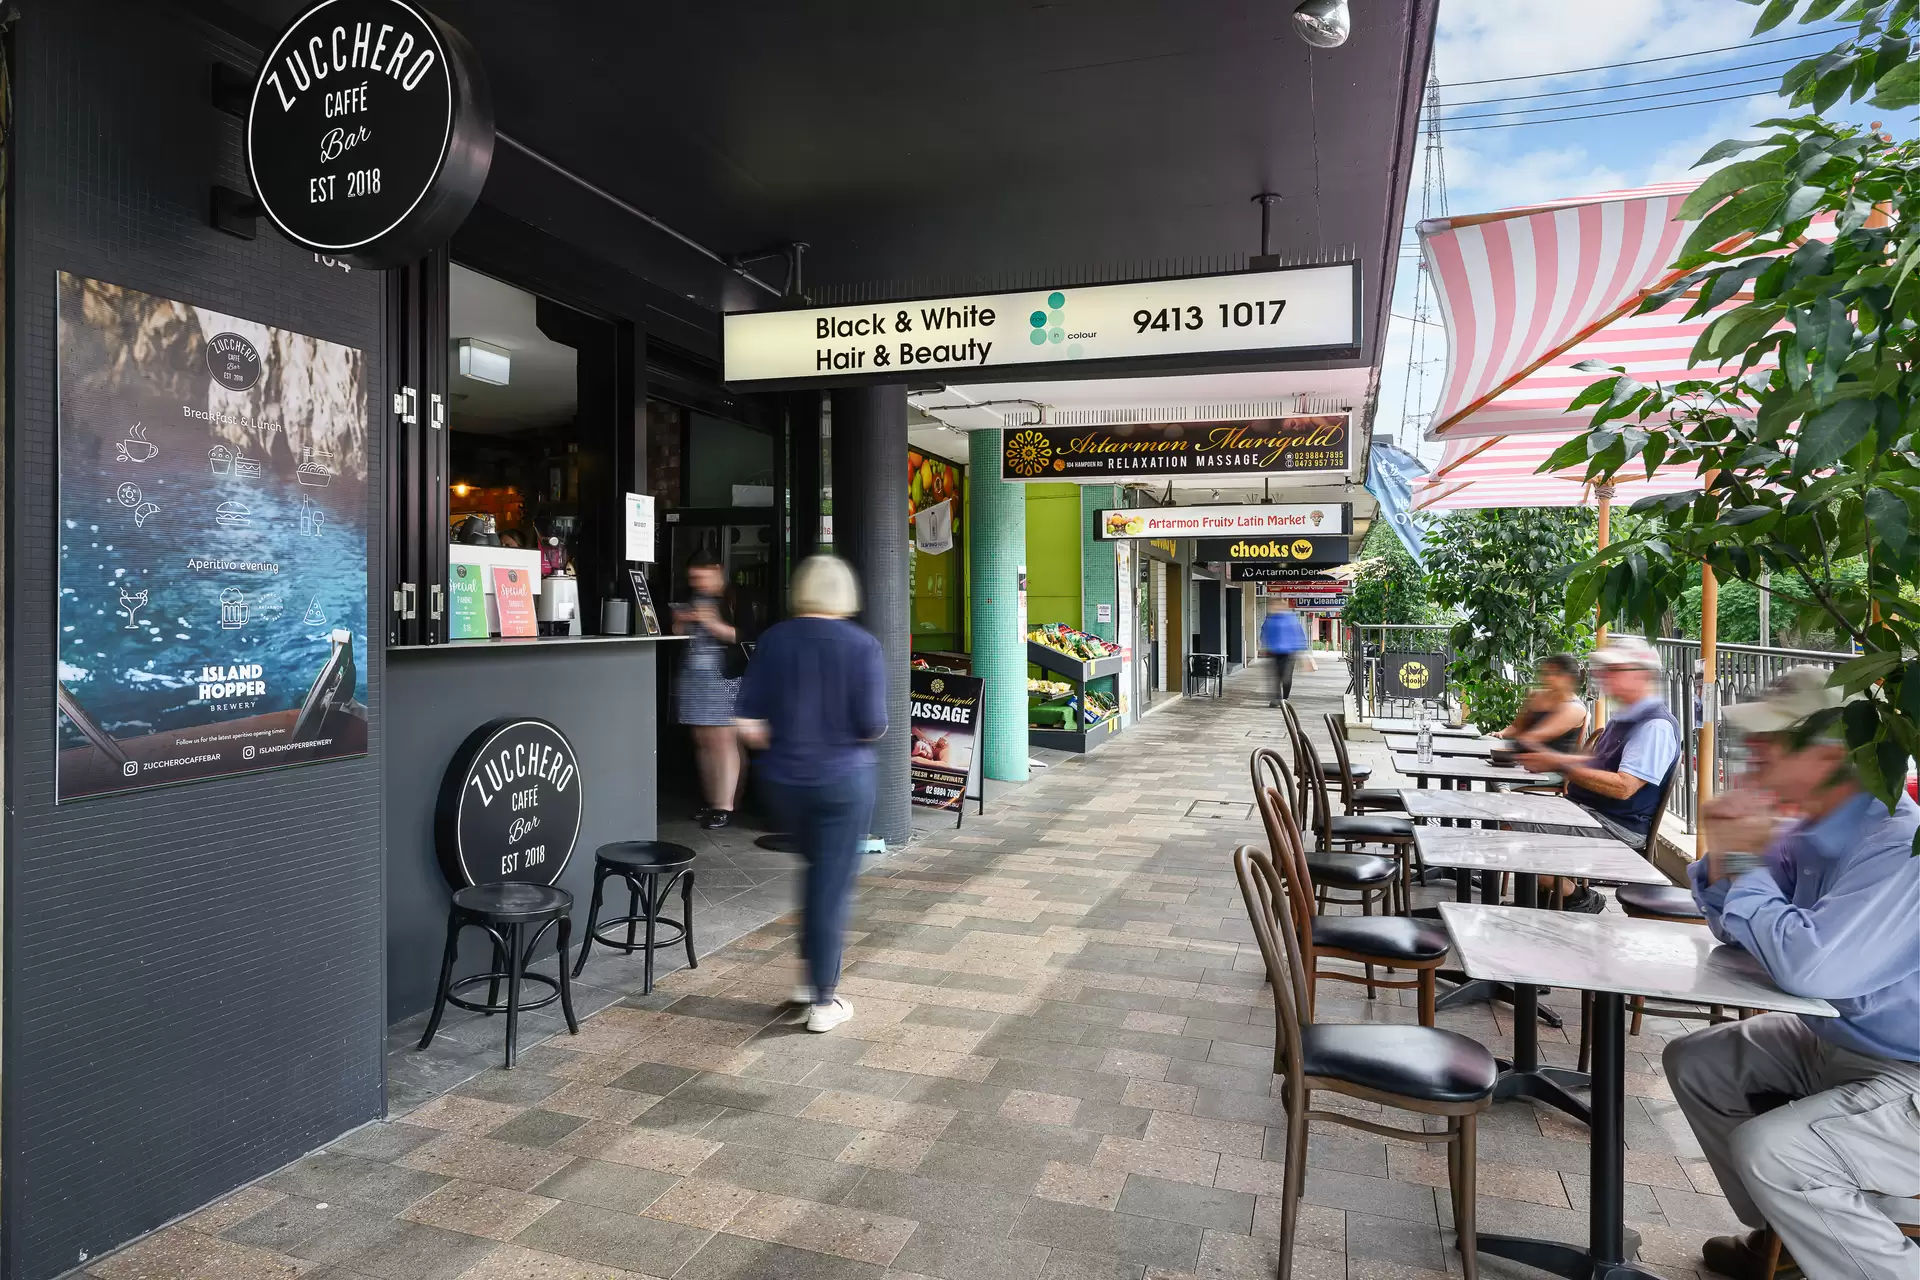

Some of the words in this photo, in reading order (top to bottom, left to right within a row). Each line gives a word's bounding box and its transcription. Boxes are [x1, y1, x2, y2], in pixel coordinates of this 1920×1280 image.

[266, 22, 435, 112] ZUCCHERO
[325, 81, 368, 118] CAFFÉ
[320, 125, 372, 164] Bar
[310, 175, 336, 203] EST
[347, 168, 381, 198] 2018
[816, 313, 886, 339] Black
[895, 310, 913, 333] &
[921, 304, 996, 331] White
[1133, 305, 1204, 334] 9413
[1219, 299, 1287, 328] 1017
[1067, 332, 1098, 340] colour
[211, 338, 257, 362] ZUCCHERO
[816, 347, 865, 371] Hair
[873, 344, 891, 367] &
[900, 338, 993, 365] Beauty
[182, 405, 238, 425] Breakfast
[240, 416, 249, 426] &
[251, 418, 283, 433] Lunch
[1055, 431, 1190, 455] Artarmon
[1194, 421, 1345, 468] Marigold
[1108, 456, 1187, 469] RELAXATION
[1196, 453, 1259, 467] MASSAGE
[1294, 452, 1304, 460] 02
[1305, 451, 1324, 460] 9884
[1325, 450, 1344, 459] 7895
[1294, 460, 1312, 468] 0473
[1314, 459, 1328, 467] 957
[1330, 458, 1344, 467] 739
[1148, 518, 1199, 529] Artarmon
[1202, 516, 1234, 528] Fruity
[1237, 516, 1264, 526] Latin
[1267, 514, 1306, 525] Market
[1230, 540, 1289, 558] chooks
[187, 558, 237, 571] Aperitivo
[240, 561, 279, 574] evening
[1255, 568, 1300, 576] Artarmon
[1298, 598, 1311, 606] Dry
[202, 664, 263, 682] ISLAND
[198, 680, 266, 699] HOPPER
[210, 701, 256, 712] BREWERY
[911, 701, 971, 724] ASSAGE
[175, 738, 193, 746] Follow
[259, 738, 333, 755] ISLANDHOPPERBREWERY
[143, 753, 221, 771] ZUCCHEROCAFFEBAR
[471, 742, 574, 808] ZUCCHERO
[911, 770, 928, 779] FRESH
[511, 784, 539, 812] CAFFÉ
[508, 815, 540, 845] Bar
[501, 852, 519, 875] EST
[525, 845, 545, 868] 2018
